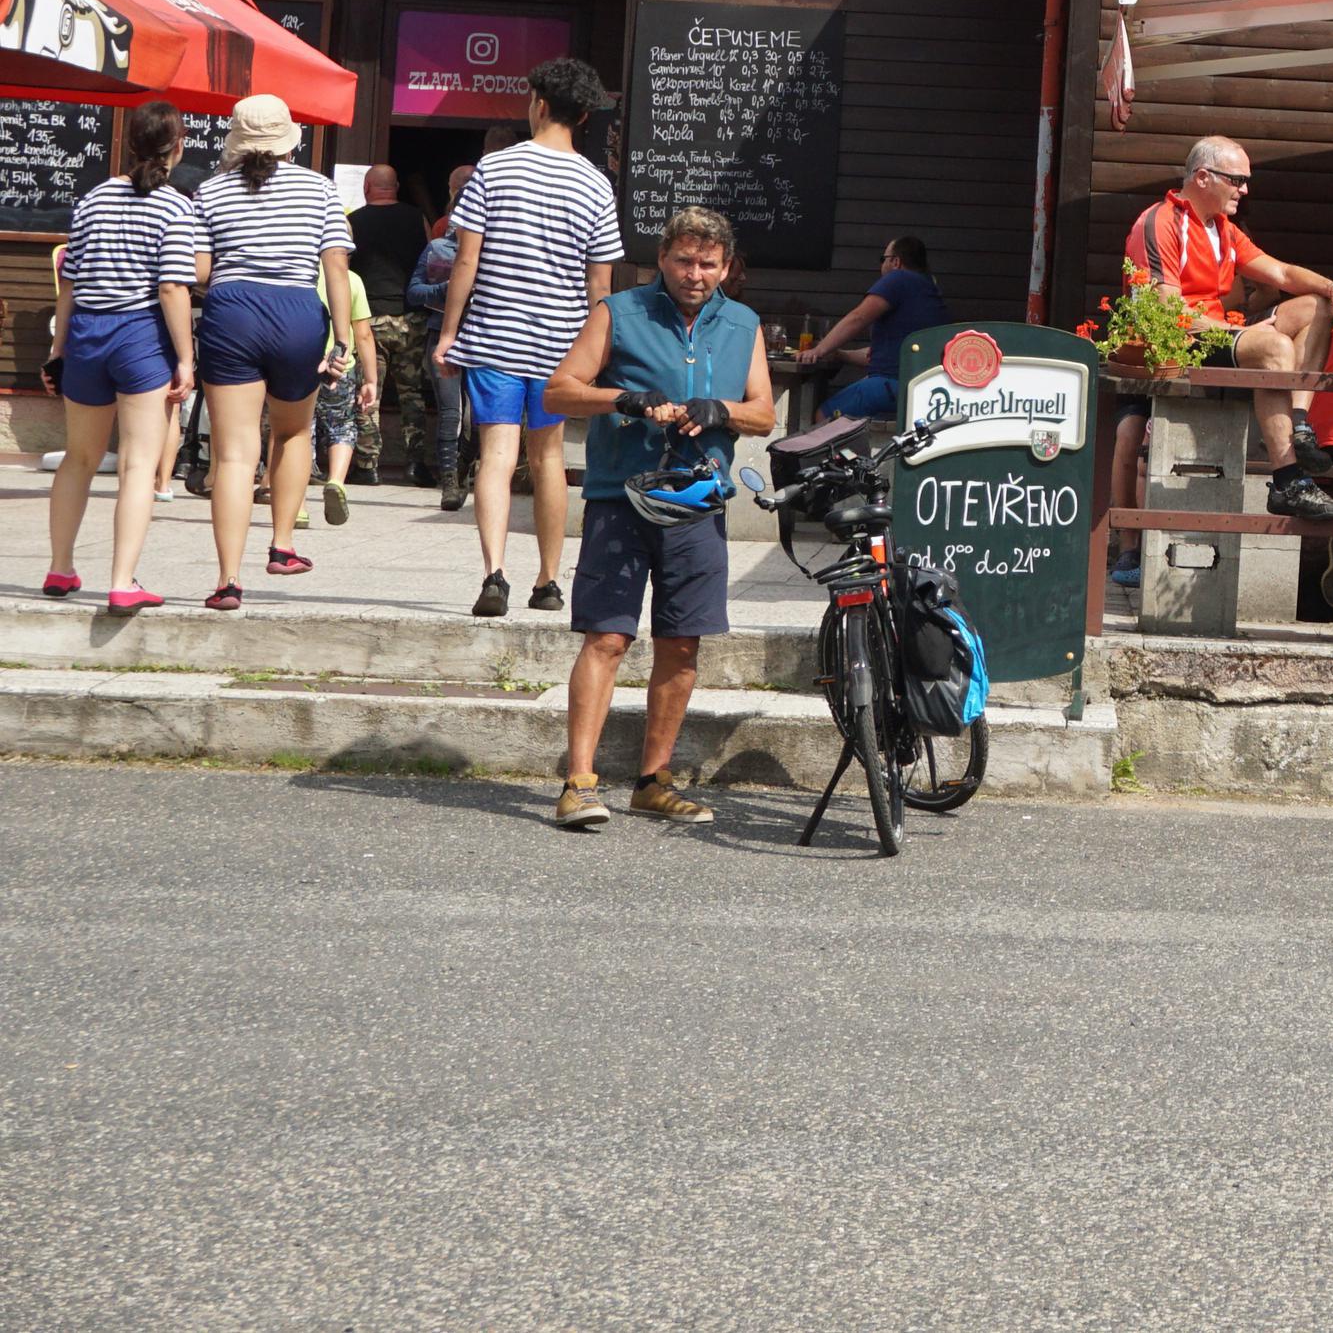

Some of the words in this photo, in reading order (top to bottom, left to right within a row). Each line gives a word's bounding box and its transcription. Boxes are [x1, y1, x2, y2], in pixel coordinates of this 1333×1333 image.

[688, 17, 802, 48] ČEPUJEME
[650, 46, 684, 62] Pilsner
[687, 48, 730, 67] Urquell
[742, 50, 759, 62] 0,3
[787, 51, 805, 63] 0,5
[648, 63, 706, 76] Gambrinus
[741, 64, 759, 77] 0,3
[408, 71, 530, 95] ZLATA_PODKO
[729, 77, 757, 92] Kozel
[652, 93, 684, 107] Birell
[652, 108, 706, 123] Malinovka
[652, 124, 694, 146] Kofola
[647, 164, 674, 186] Cappy
[633, 190, 648, 203] 0,5
[650, 190, 669, 204] Bad
[999, 388, 1066, 425] Urquell
[916, 473, 1078, 531] OTEVŘENO
[976, 548, 1009, 575] do
